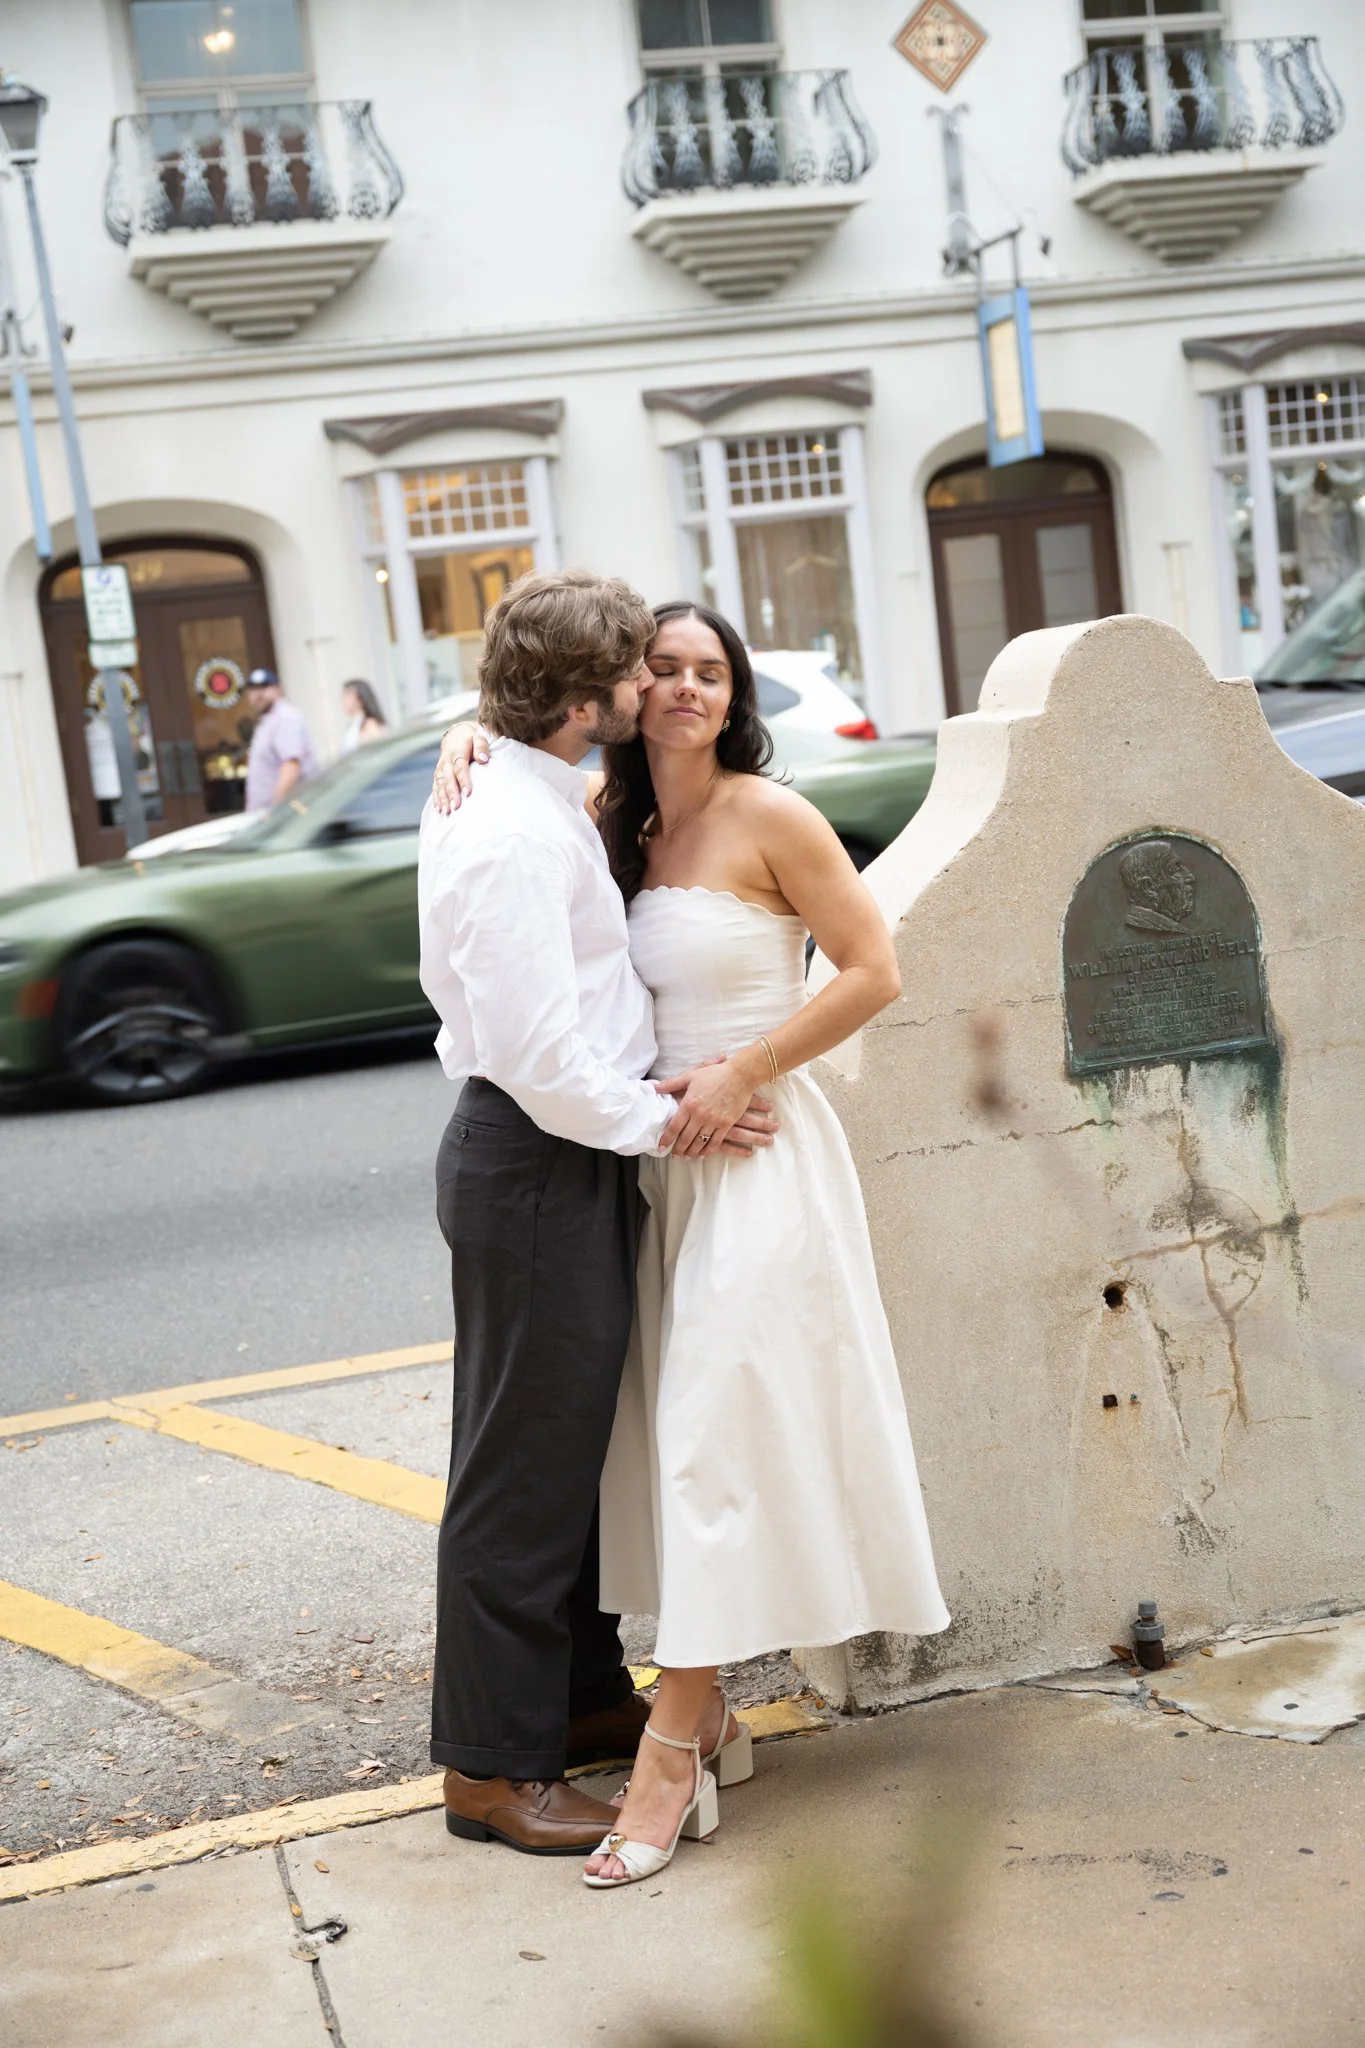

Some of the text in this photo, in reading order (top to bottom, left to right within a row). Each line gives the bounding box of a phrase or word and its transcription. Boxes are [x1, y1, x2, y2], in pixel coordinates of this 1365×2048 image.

[1100, 931, 1224, 960] IN LOVING MEMORY OF
[1068, 940, 1255, 979] WILLIAM HOWLAND PELL
[1112, 972, 1218, 997] WHO ERECTED THIS
[1127, 973, 1142, 983] OF
[1146, 969, 1170, 981] NEW
[1116, 991, 1171, 1009] FOUNTAIN
[1174, 989, 1186, 999] IN
[1144, 1000, 1185, 1015] WINTER
[1188, 991, 1240, 1008] RESIDENT
[1087, 1024, 1102, 1034] OF
[1104, 1019, 1128, 1032] THIS
[1101, 1033, 1120, 1044] AND
[1153, 1024, 1182, 1037] HERE
